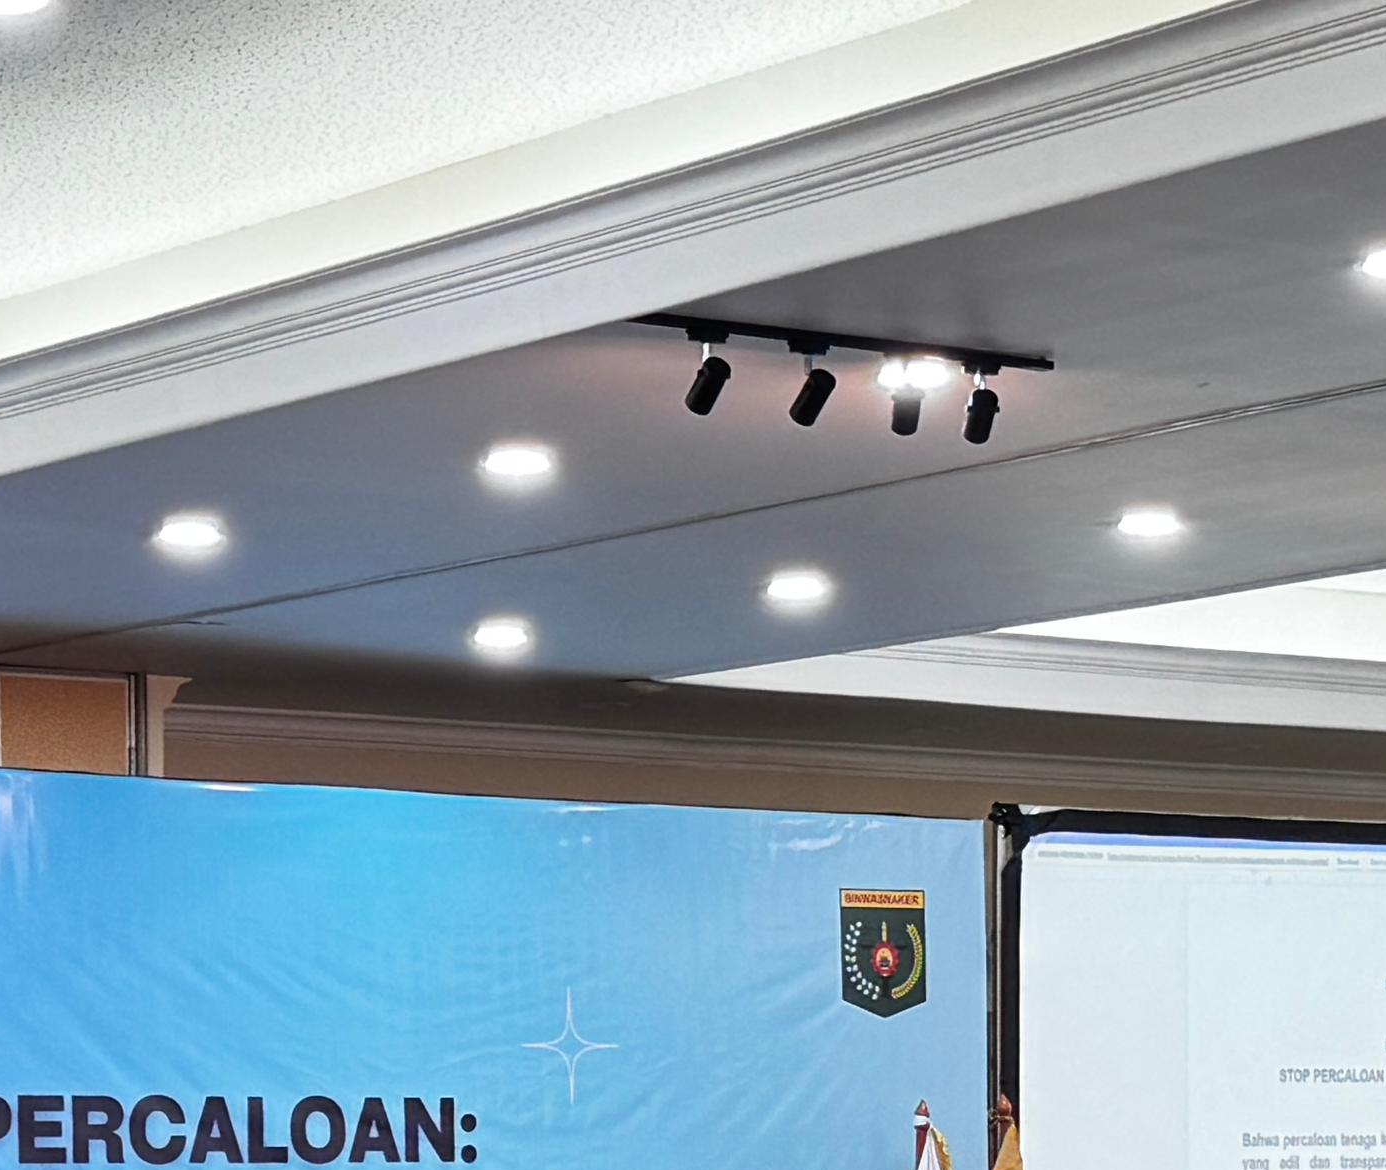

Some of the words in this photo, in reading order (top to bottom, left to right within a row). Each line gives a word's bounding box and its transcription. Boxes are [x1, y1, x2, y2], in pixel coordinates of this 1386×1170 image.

[1279, 1068, 1310, 1084] STOP
[1312, 1068, 1384, 1084] PERCALOAN
[1283, 1133, 1337, 1150] percaloan
[1340, 1132, 1377, 1150] tenaga
[1309, 1155, 1330, 1169] dan
